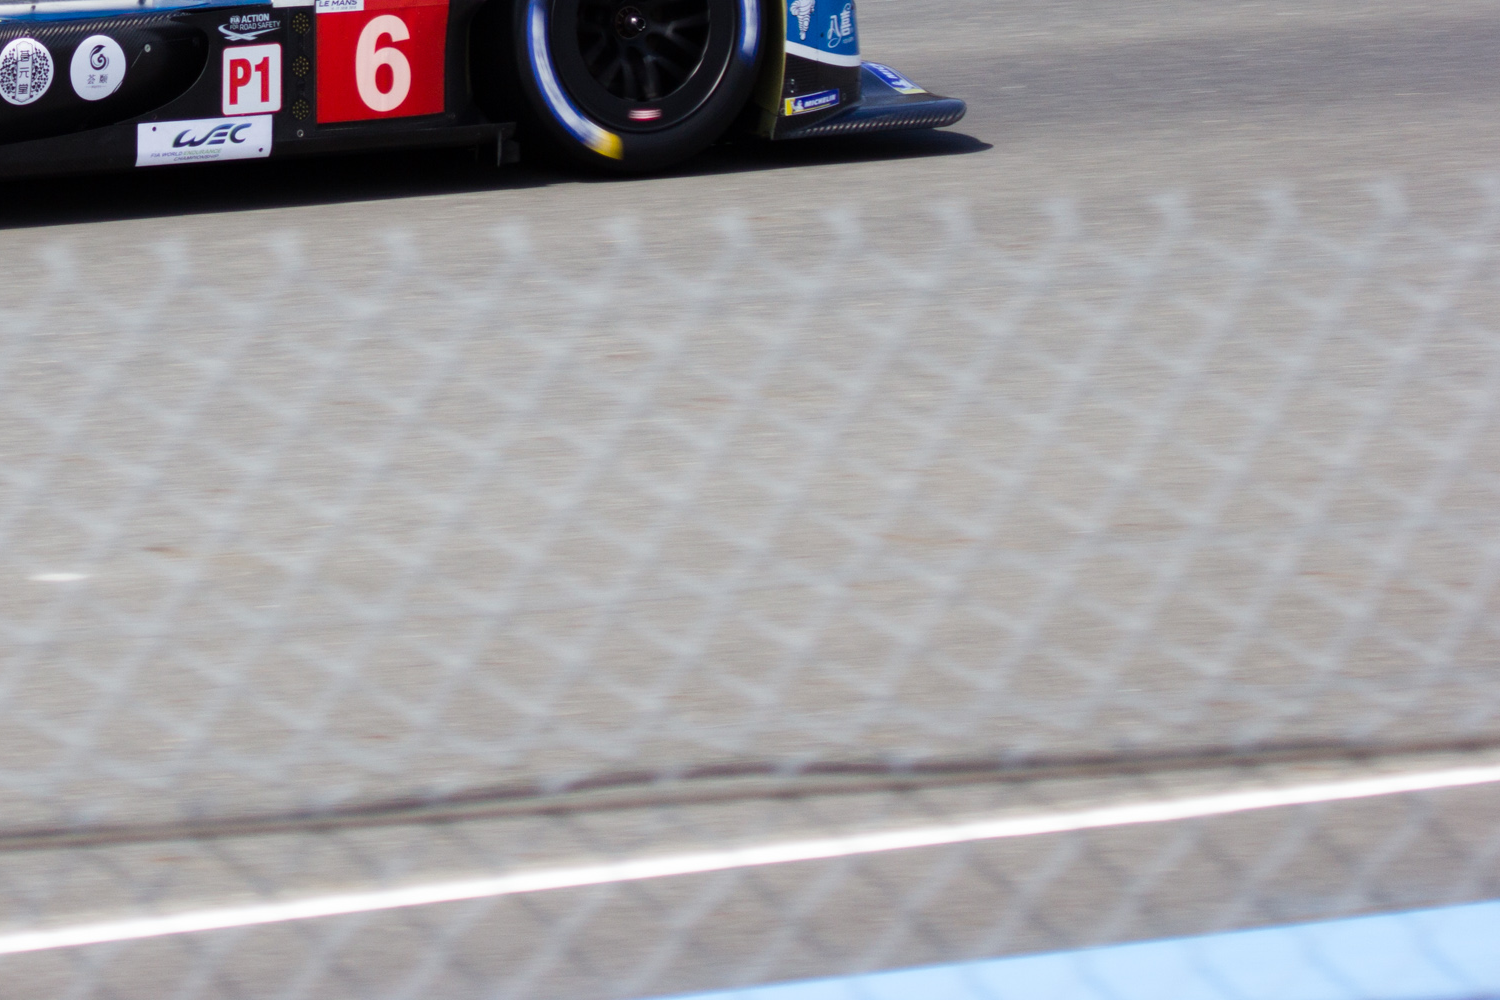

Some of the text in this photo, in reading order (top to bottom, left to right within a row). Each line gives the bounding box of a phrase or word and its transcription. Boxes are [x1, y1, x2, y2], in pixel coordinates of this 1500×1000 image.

[319, 0, 330, 8] LE
[240, 23, 257, 31] ROAD
[257, 20, 281, 29] SAFETY
[241, 13, 270, 24] ACTION
[355, 14, 412, 112] 6
[229, 56, 270, 106] P1
[804, 93, 837, 108] MICHELIN
[172, 123, 252, 148] WEC
